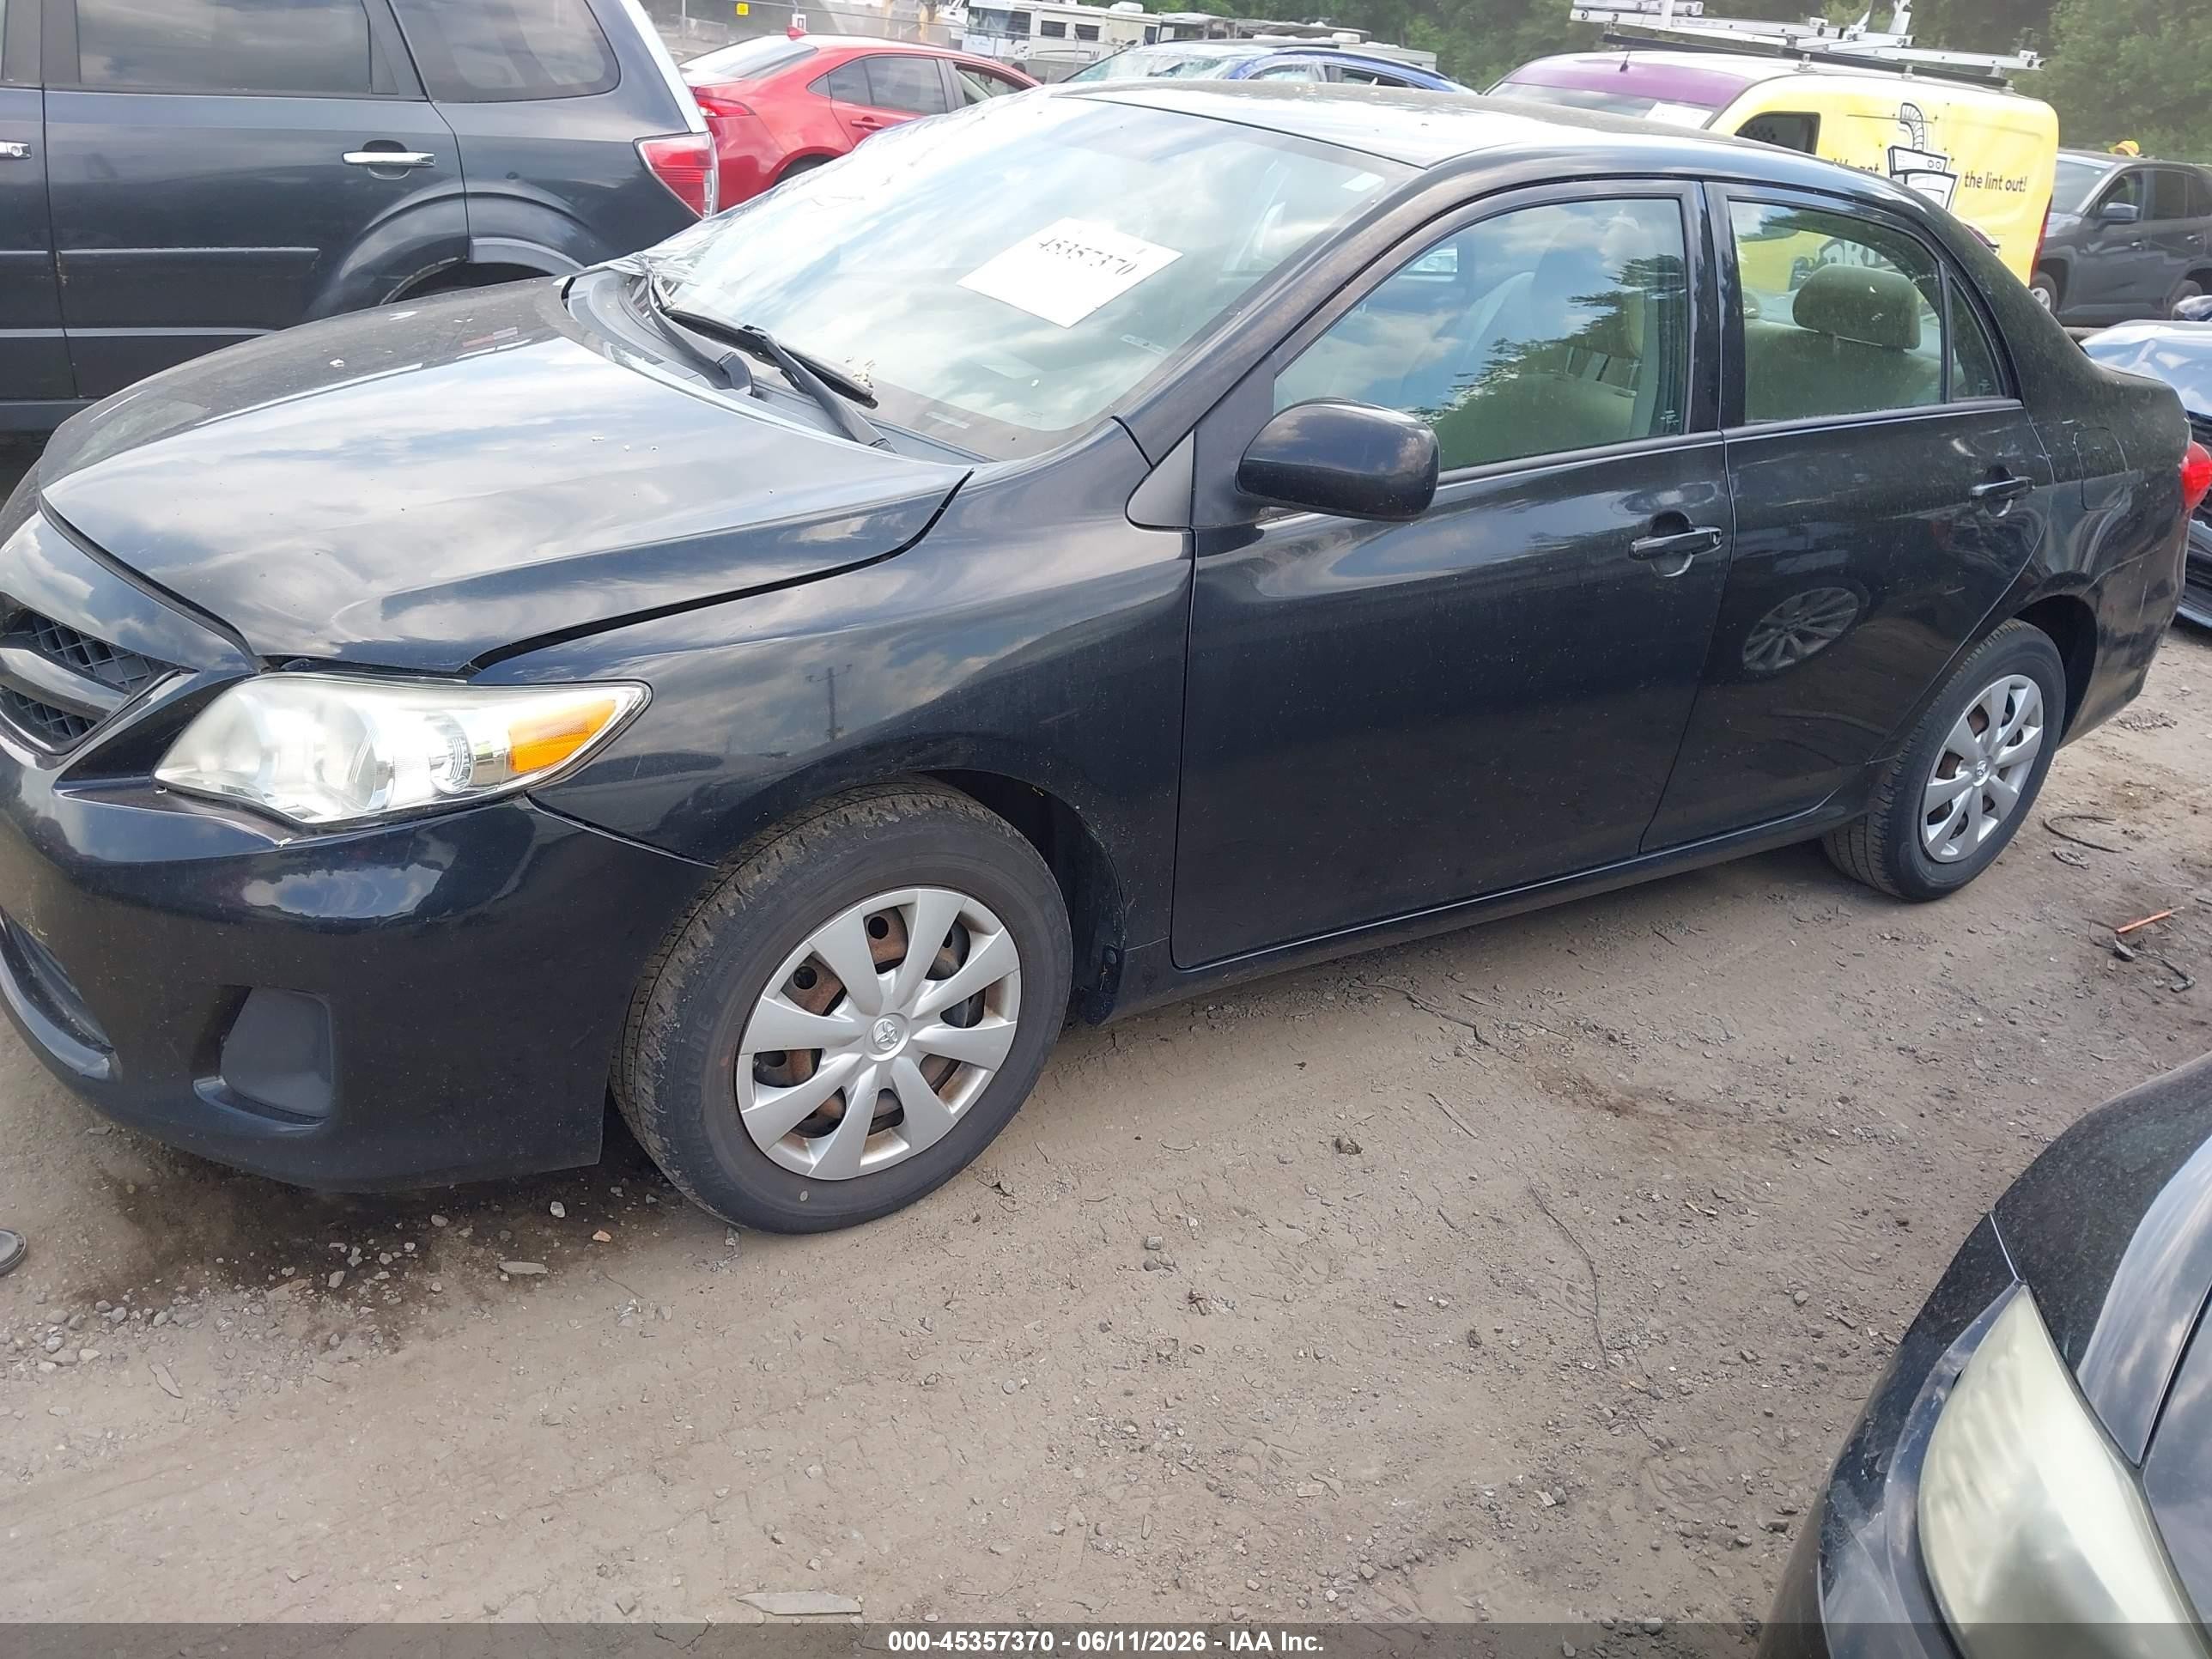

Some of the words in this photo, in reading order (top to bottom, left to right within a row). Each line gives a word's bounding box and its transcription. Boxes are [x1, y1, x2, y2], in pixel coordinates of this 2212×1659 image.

[1964, 170, 1983, 188] the
[1984, 171, 2003, 191] lint
[2005, 175, 2027, 192] out!
